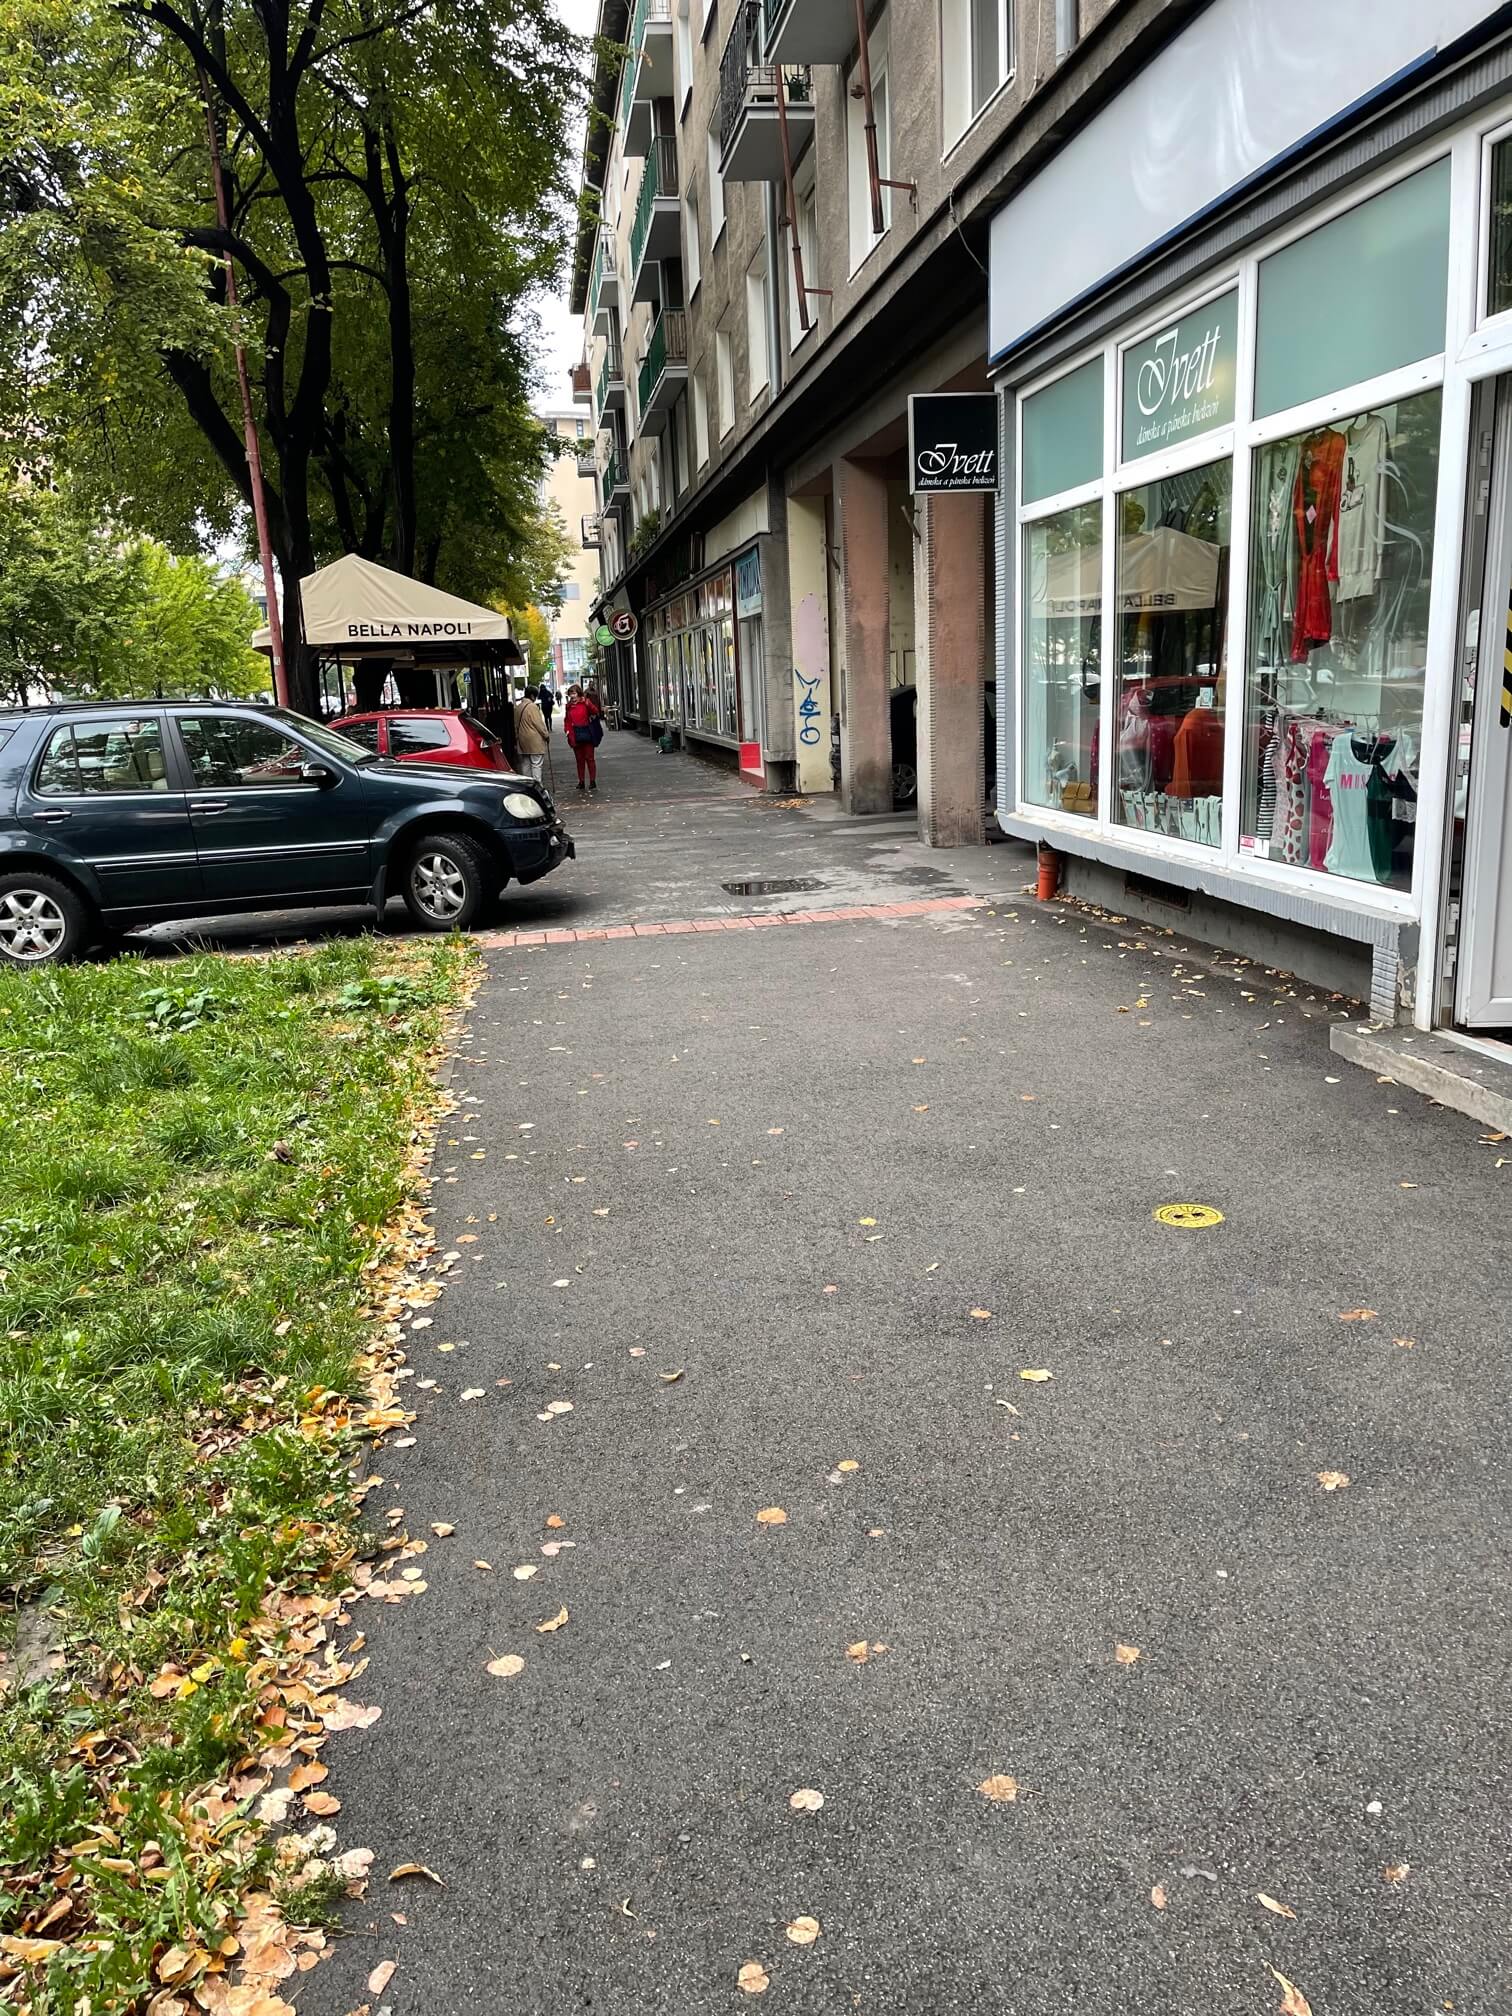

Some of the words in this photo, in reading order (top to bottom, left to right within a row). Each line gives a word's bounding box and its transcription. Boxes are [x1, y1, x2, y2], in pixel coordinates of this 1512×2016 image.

[917, 443, 995, 475] Ivett
[348, 624, 402, 637] BELLA
[407, 622, 472, 636] NAPOLI
